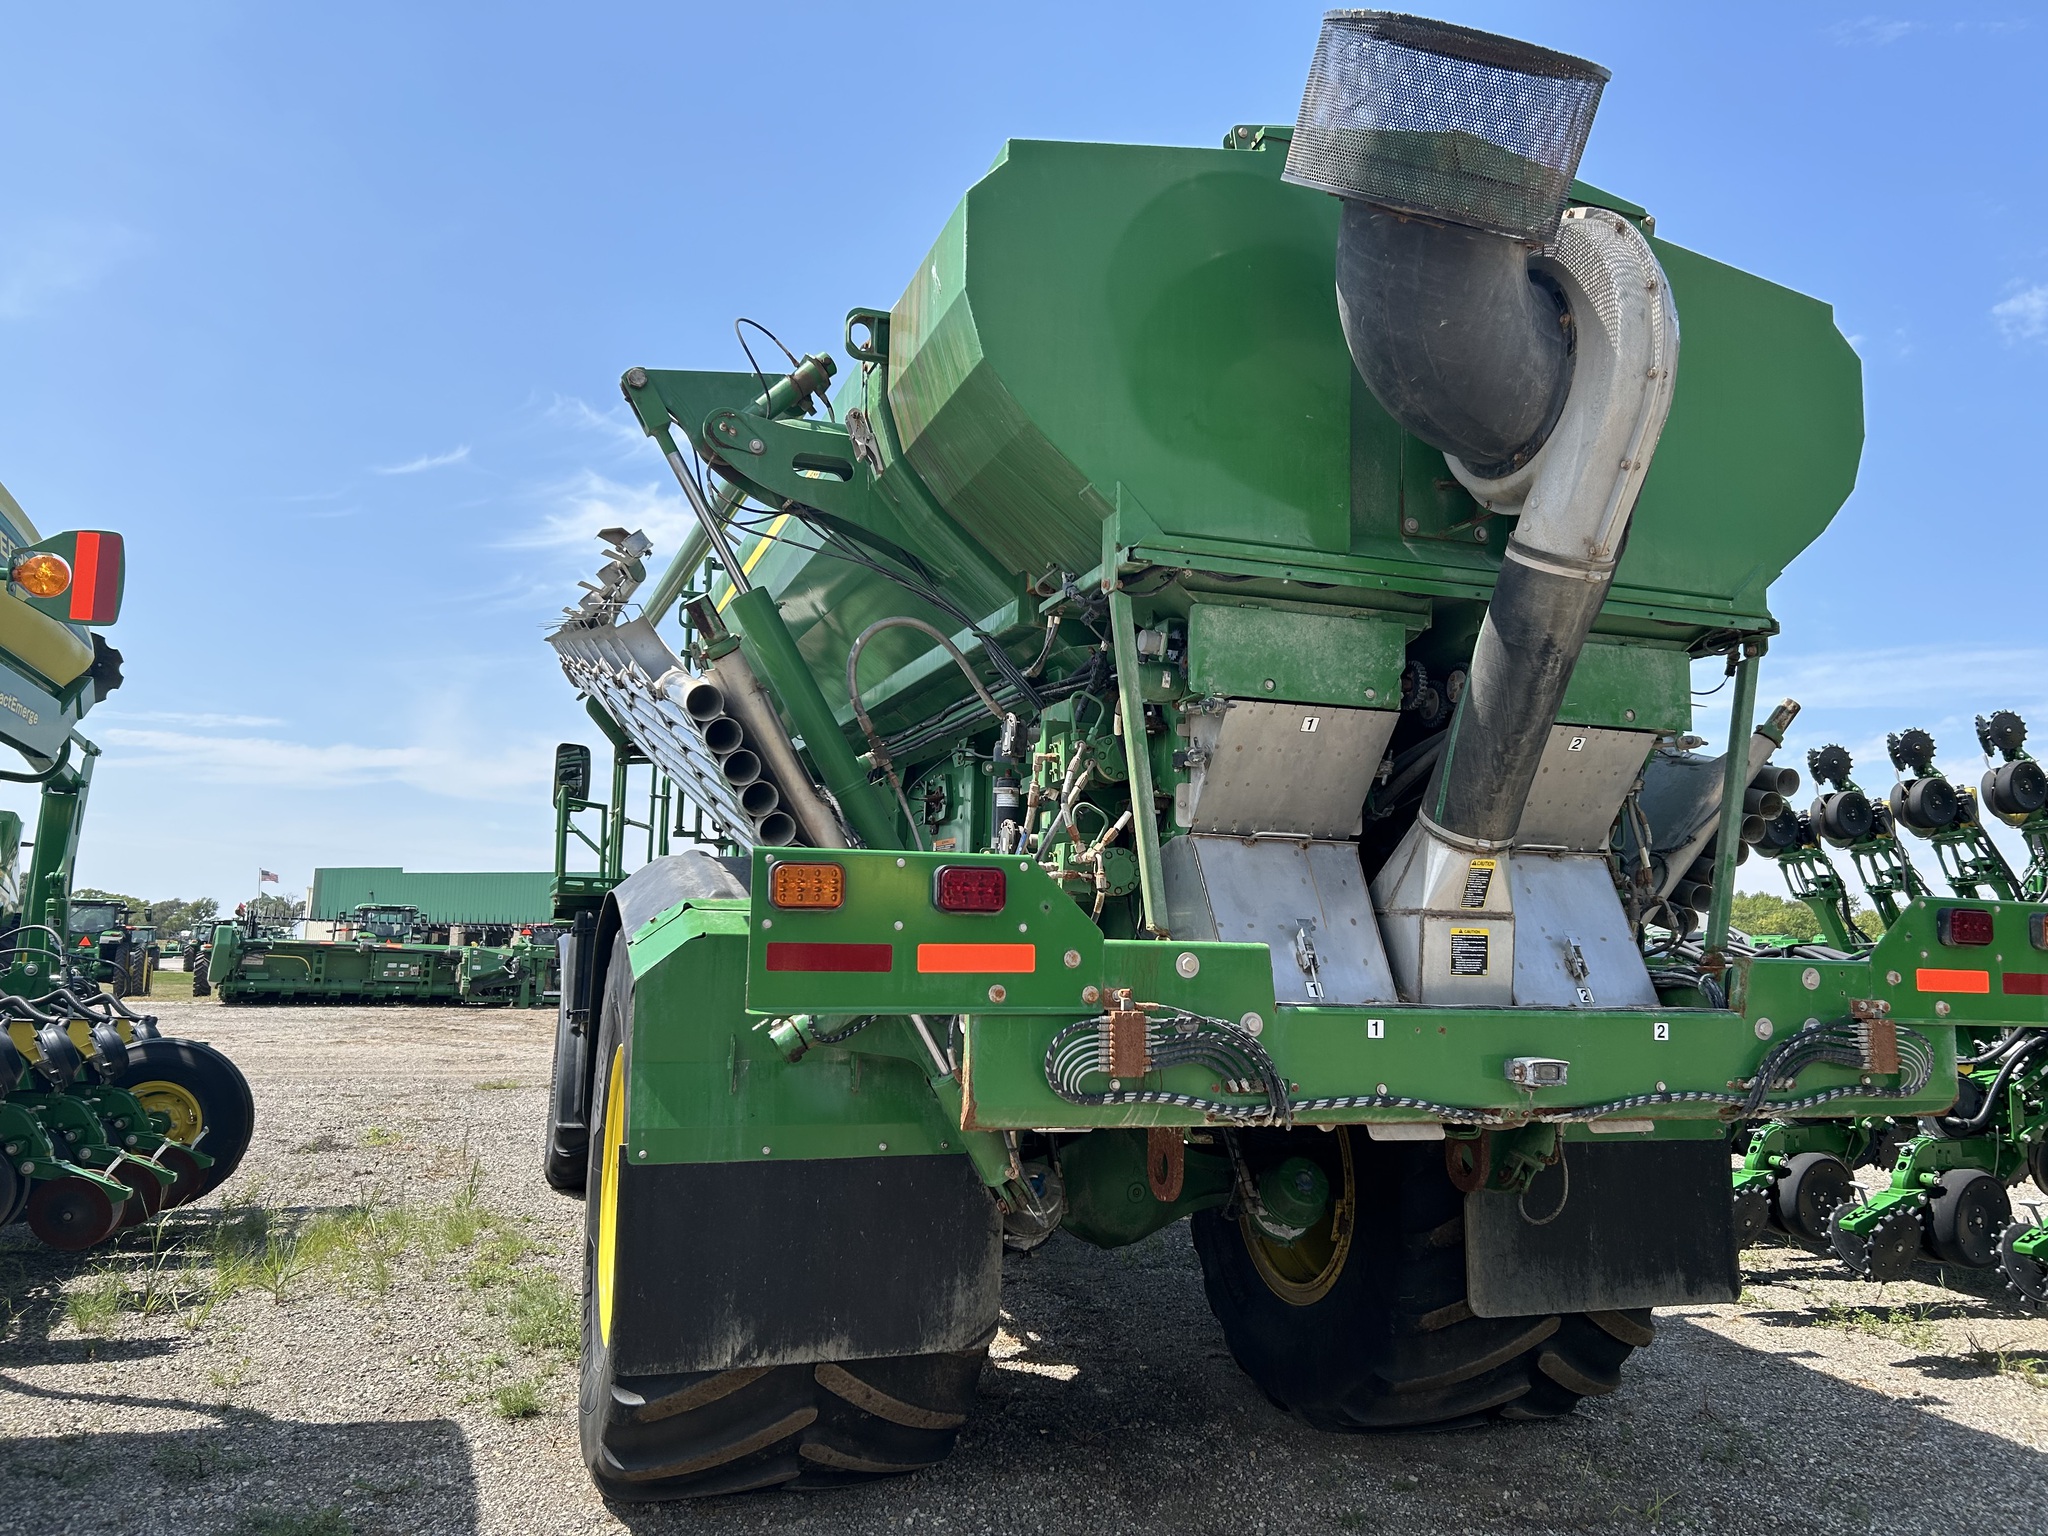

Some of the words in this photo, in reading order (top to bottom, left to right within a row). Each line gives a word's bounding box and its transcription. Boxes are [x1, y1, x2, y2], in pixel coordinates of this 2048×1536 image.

[1307, 718, 1314, 730] 1
[1571, 738, 1582, 750] 2
[1310, 983, 1318, 996] 1
[1580, 989, 1589, 1001] 2
[1371, 1021, 1378, 1036] 1
[1657, 1024, 1665, 1039] 2
